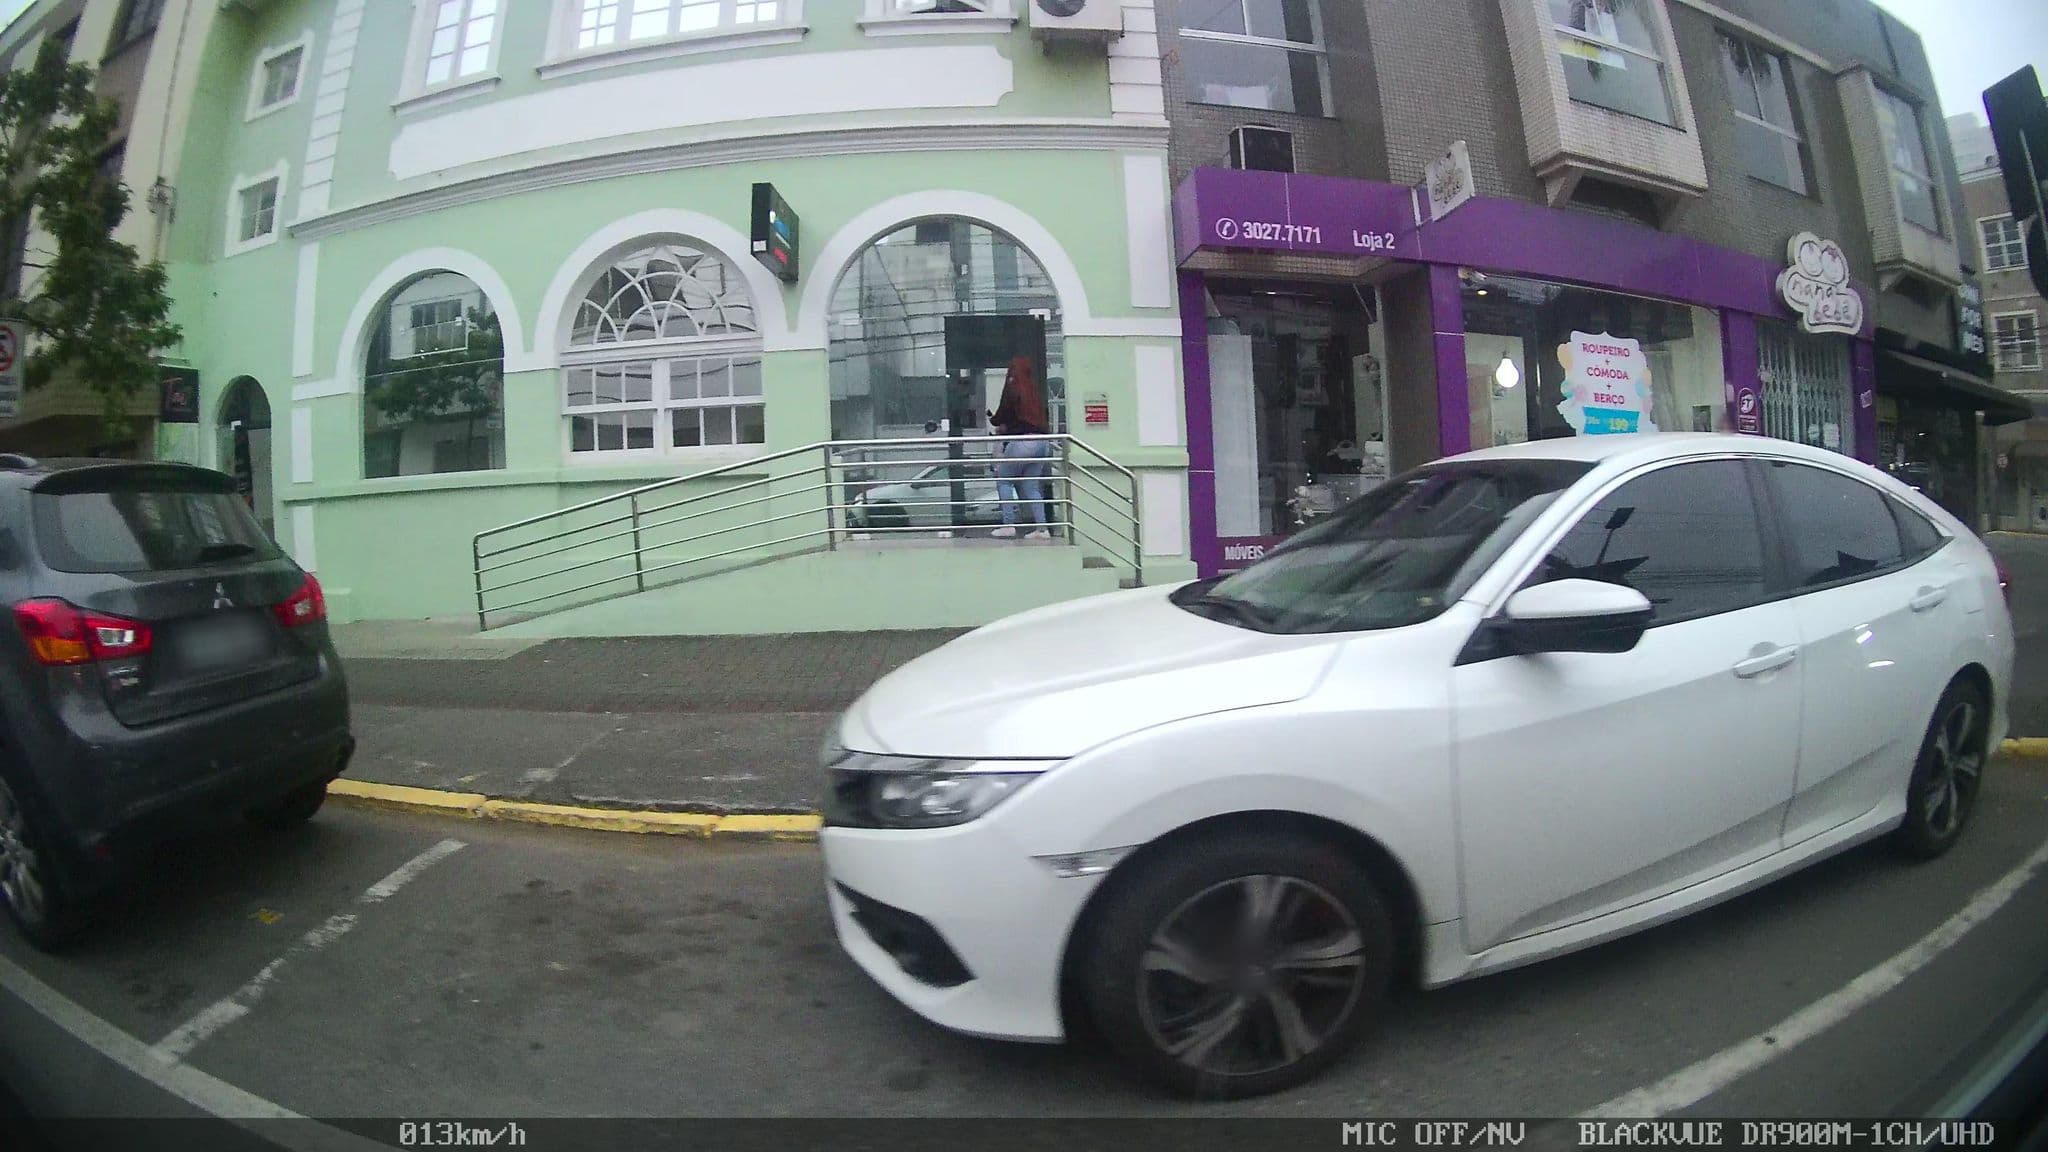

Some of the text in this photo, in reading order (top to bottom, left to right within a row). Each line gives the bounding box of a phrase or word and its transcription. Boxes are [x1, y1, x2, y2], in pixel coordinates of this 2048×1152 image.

[1242, 221, 1321, 244] 3027.7171
[1353, 230, 1395, 251] Loja 2
[1582, 343, 1630, 357] ROUPEIRO
[1586, 365, 1629, 380] CÔMODA
[1225, 543, 1265, 560] MÓVEIS
